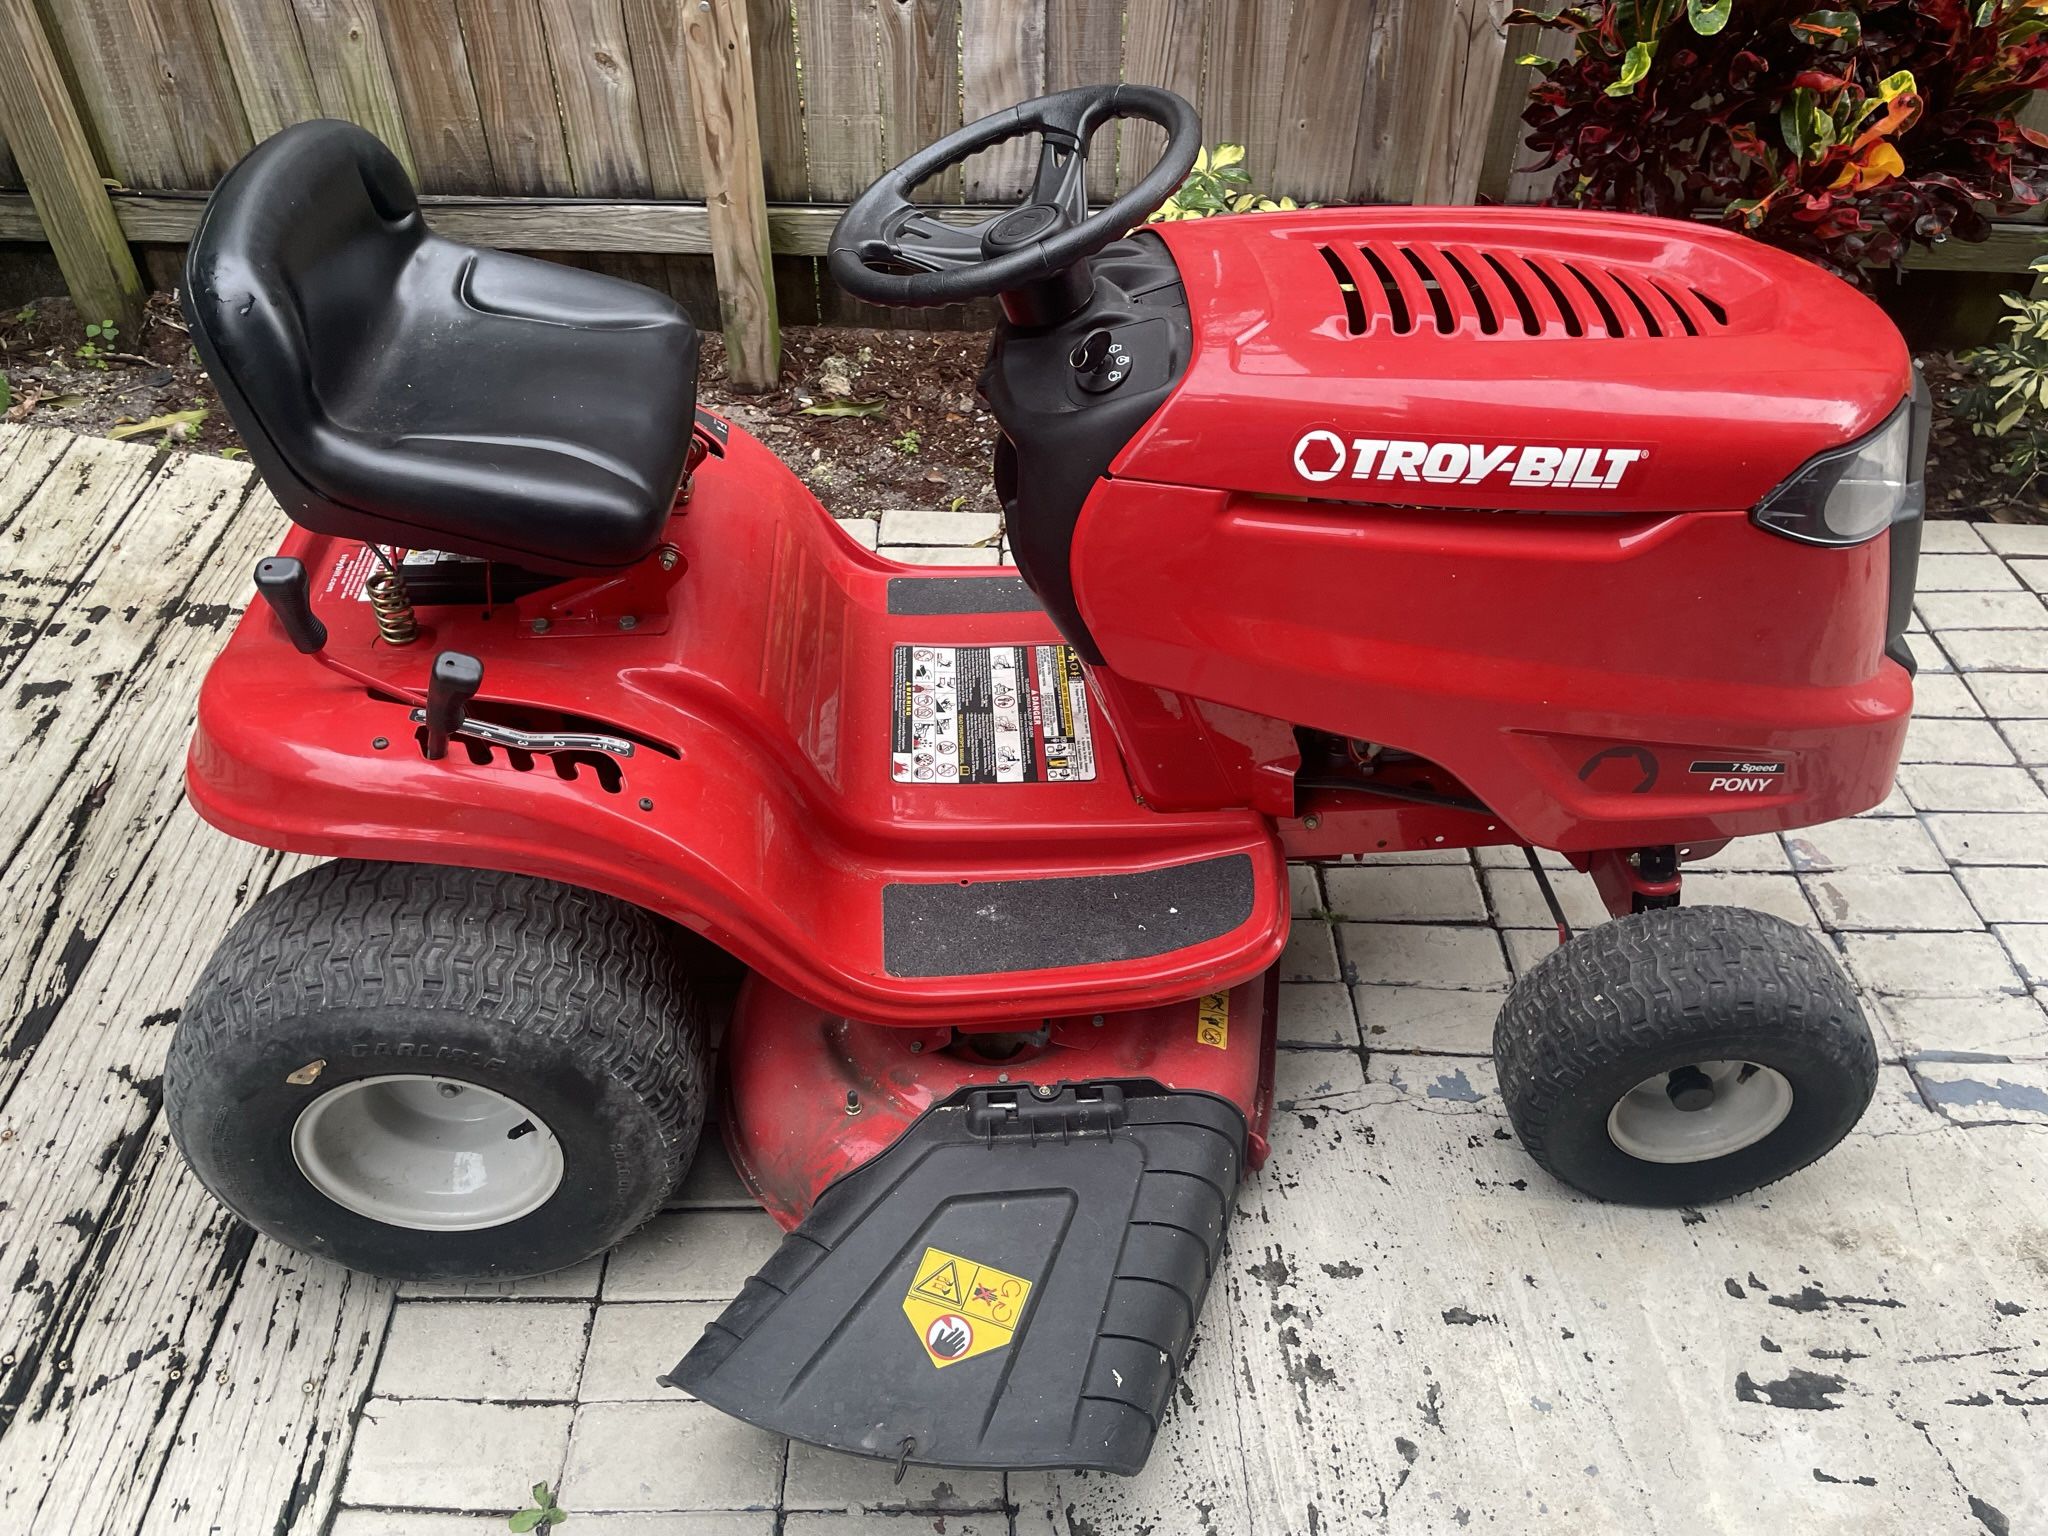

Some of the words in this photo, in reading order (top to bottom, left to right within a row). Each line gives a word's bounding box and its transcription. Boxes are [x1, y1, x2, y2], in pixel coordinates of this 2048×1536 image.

[1351, 438, 1641, 489] TROY-BILT
[1031, 696, 1042, 726] DANGER
[517, 739, 529, 747] 3
[553, 740, 566, 748] 2
[1731, 763, 1740, 772] 7
[1741, 763, 1778, 774] Speed
[1709, 777, 1774, 792] PONY
